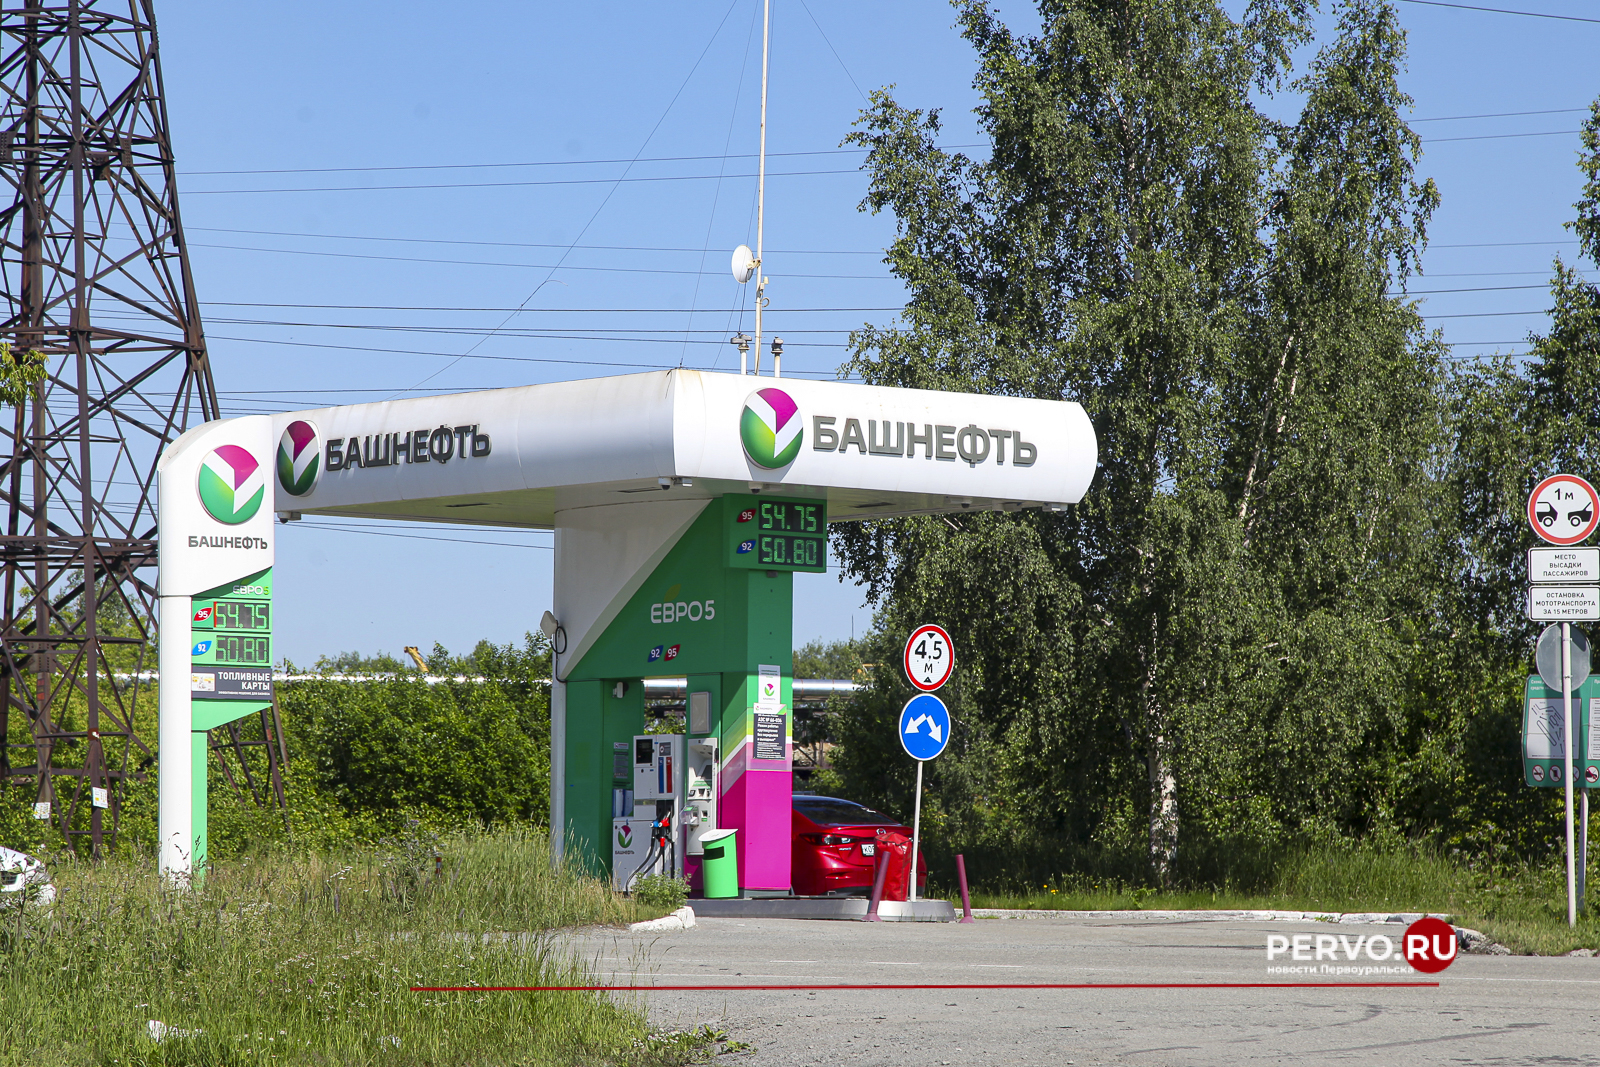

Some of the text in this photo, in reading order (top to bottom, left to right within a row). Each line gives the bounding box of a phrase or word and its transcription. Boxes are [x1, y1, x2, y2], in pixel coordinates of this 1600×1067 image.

[813, 415, 1038, 468] БАШНЕФТЬ
[325, 423, 492, 471] БАШНЕФТЬ
[1555, 488, 1561, 500] 1
[741, 511, 753, 520] 95
[761, 503, 817, 531] 54.75
[188, 535, 268, 549] БАШНЕФТЬ
[741, 542, 752, 551] 92
[761, 537, 817, 565] 50.80
[232, 585, 270, 595] ЕВРО5
[197, 610, 209, 619] 95
[215, 603, 267, 629] 54.75
[197, 643, 207, 652] 92
[215, 637, 267, 663] 50.80
[650, 648, 661, 658] 92
[667, 648, 678, 658] 95
[217, 671, 271, 681] ТОПЛИВНЫЕ
[241, 681, 270, 691] КАРТЫ
